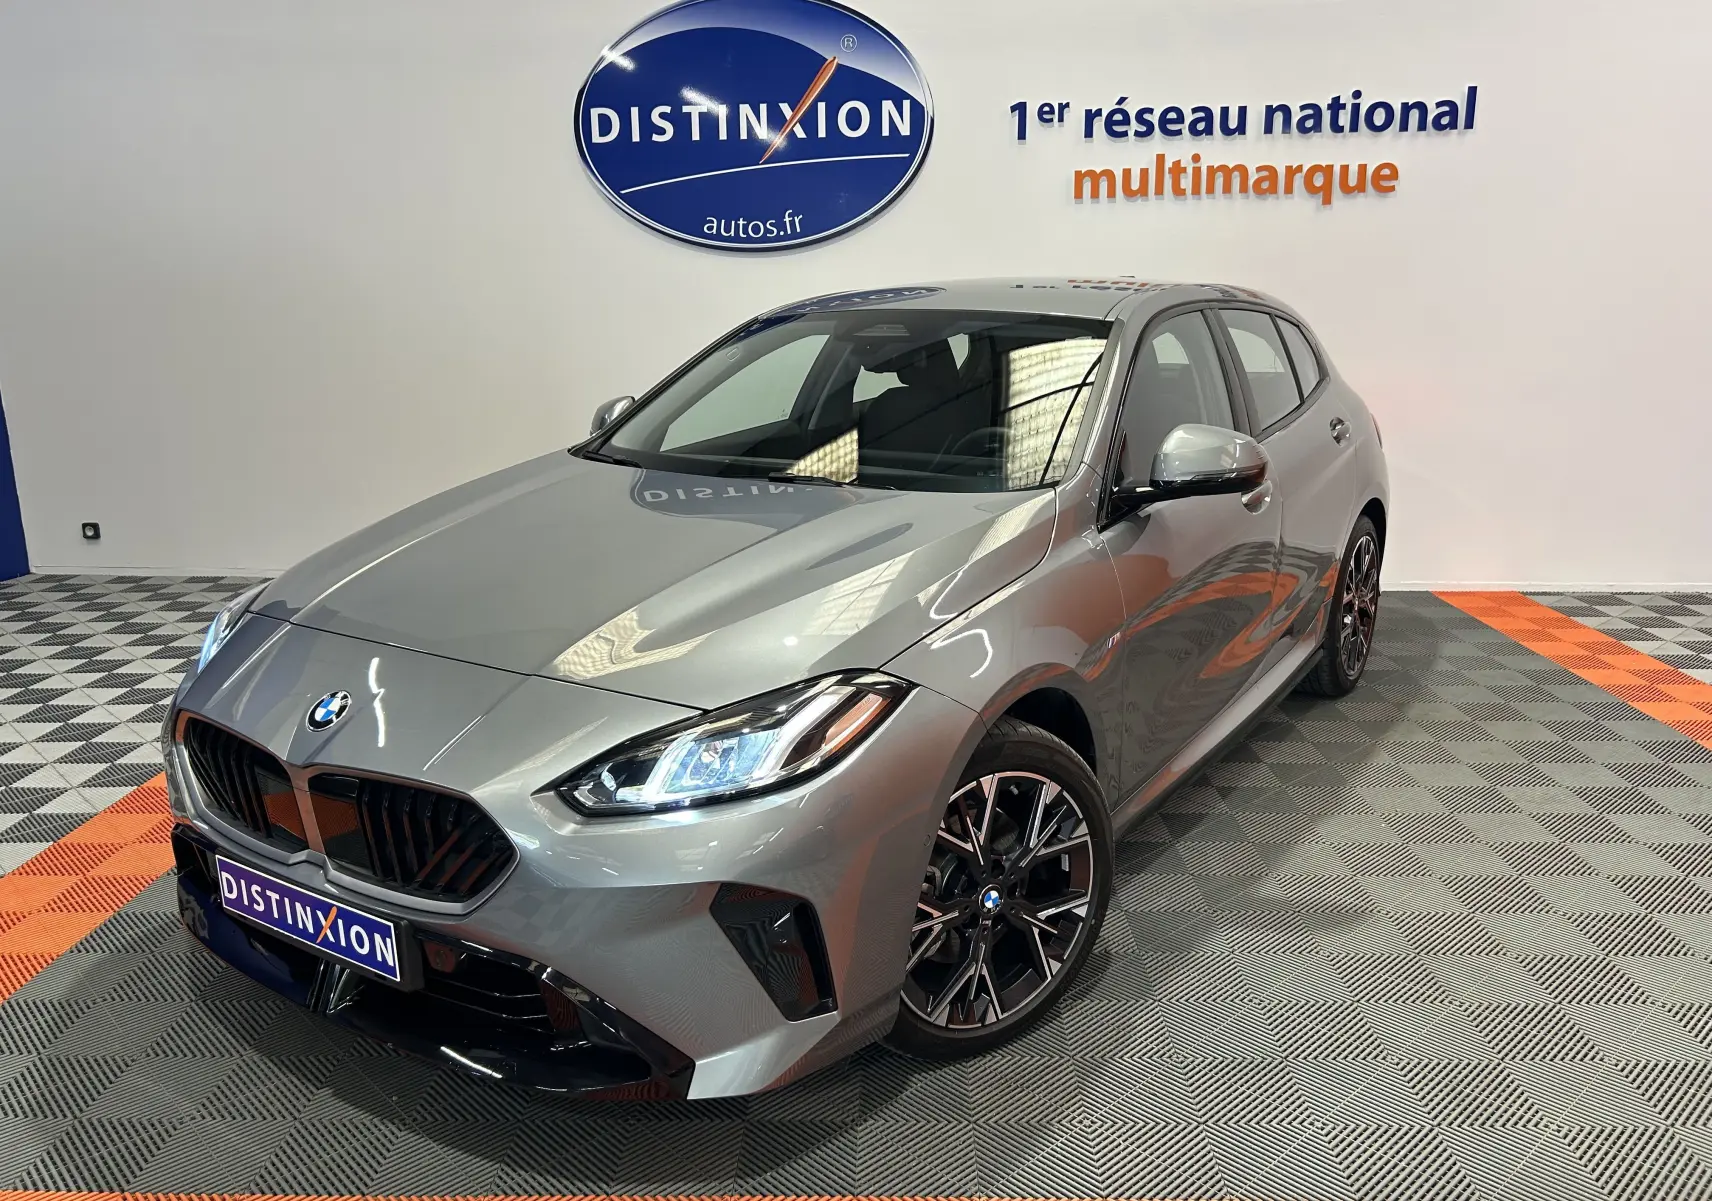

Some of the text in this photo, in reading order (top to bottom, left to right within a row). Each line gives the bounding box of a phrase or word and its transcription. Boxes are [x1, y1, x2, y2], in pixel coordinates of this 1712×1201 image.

[590, 99, 911, 144] DISTINXION
[1009, 86, 1478, 141] 1er réseau national
[1073, 153, 1399, 206] multimarque
[703, 210, 803, 238] autos.fr
[221, 871, 395, 967] DISTINXION
